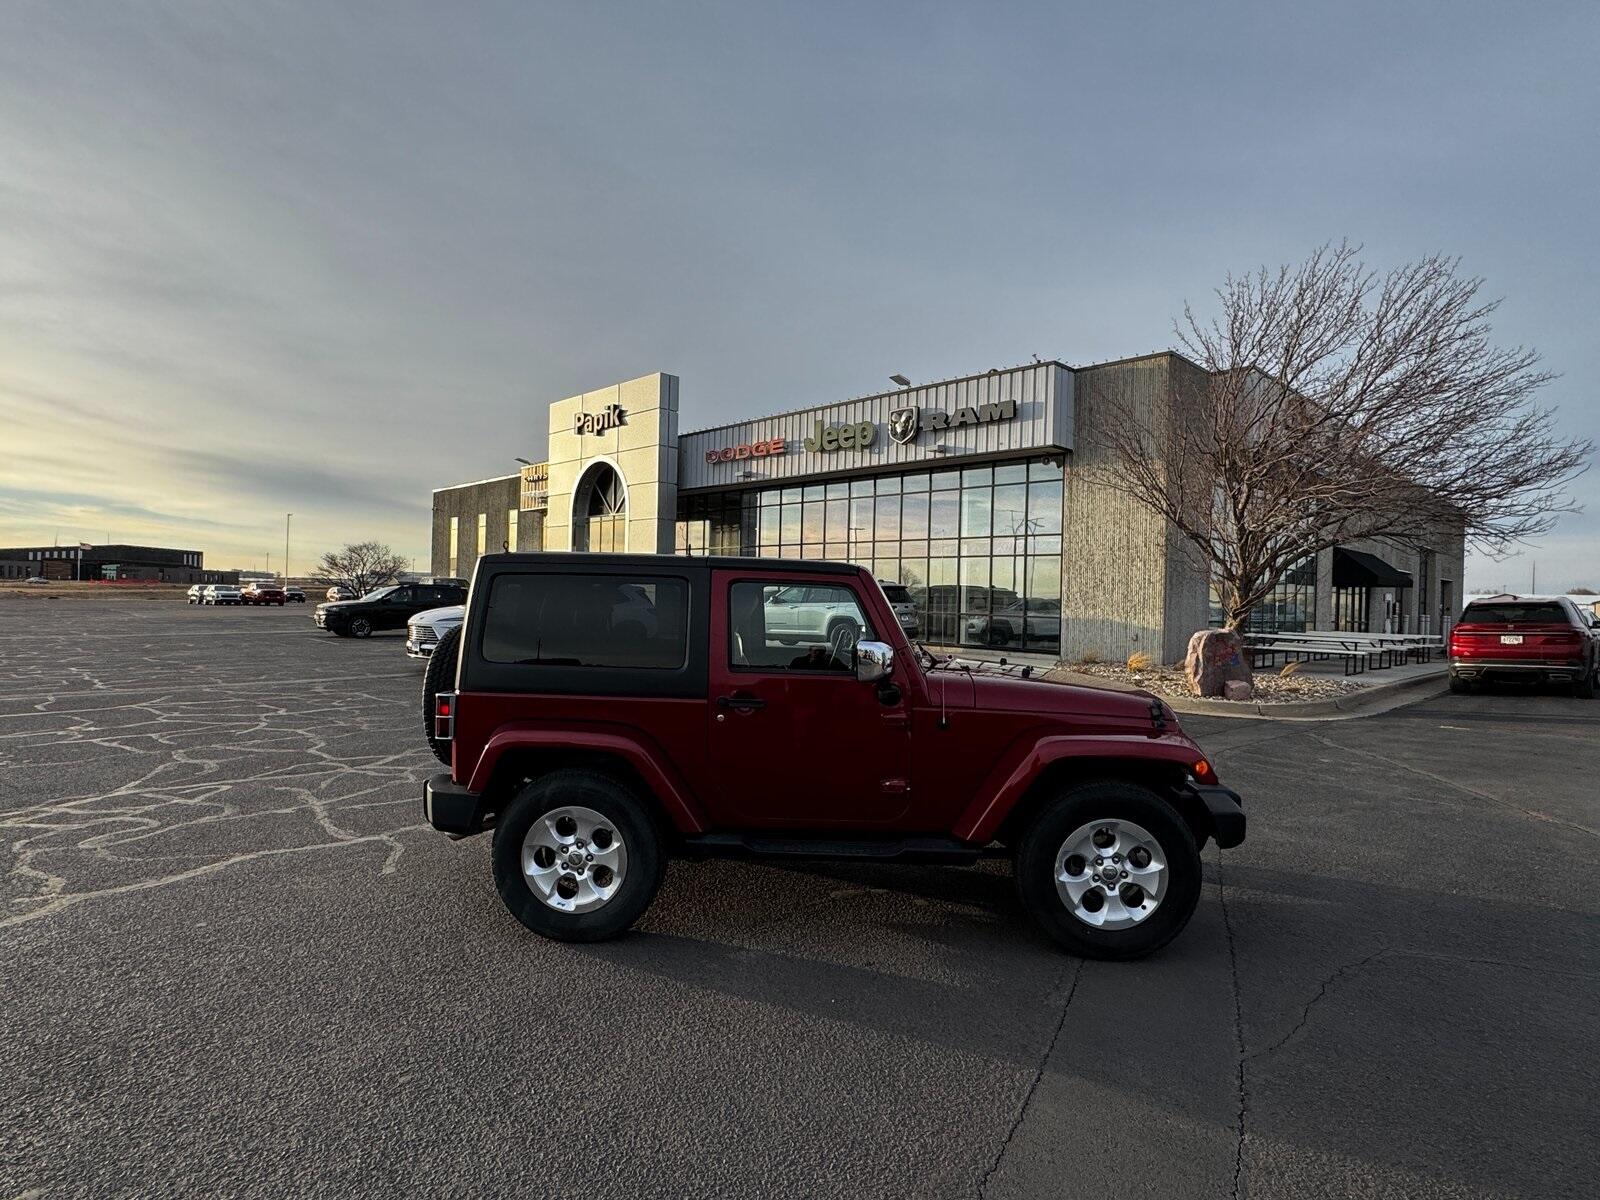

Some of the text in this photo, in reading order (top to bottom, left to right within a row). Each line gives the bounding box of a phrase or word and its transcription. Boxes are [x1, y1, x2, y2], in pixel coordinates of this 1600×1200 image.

[574, 404, 622, 436] Papik
[920, 400, 1016, 431] RAM
[706, 438, 786, 464] DODGE
[804, 420, 876, 453] Jeep
